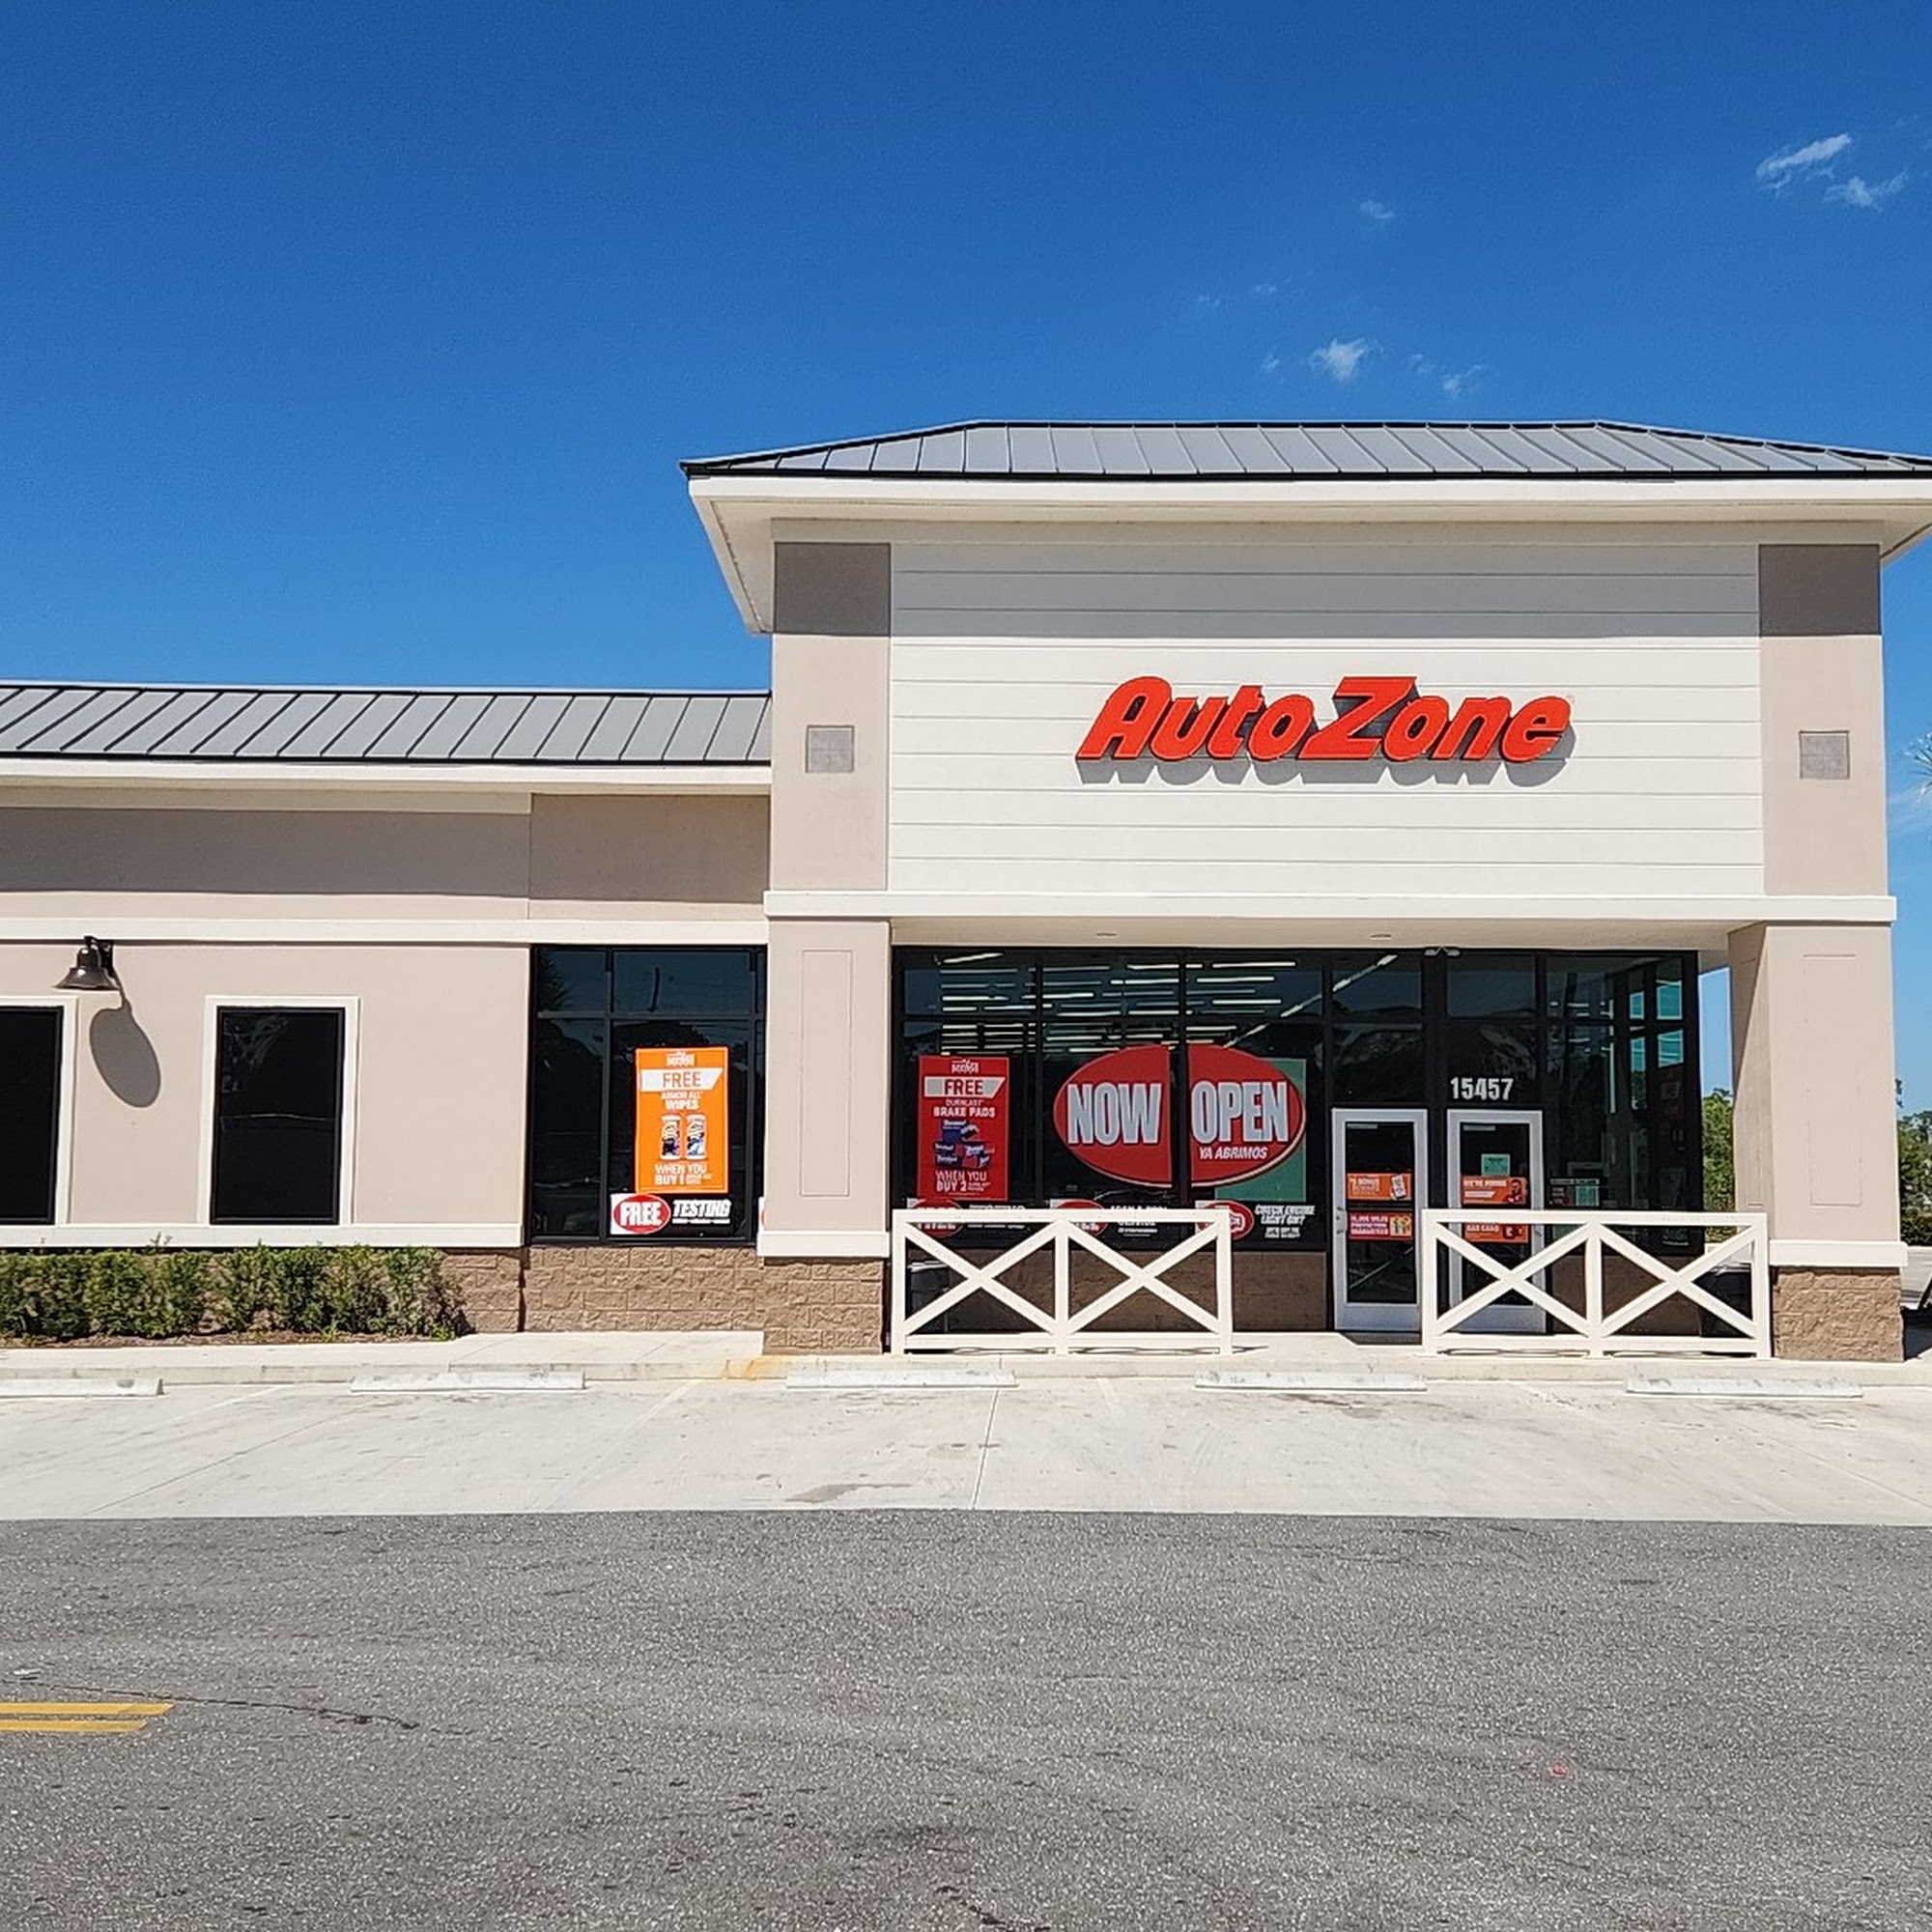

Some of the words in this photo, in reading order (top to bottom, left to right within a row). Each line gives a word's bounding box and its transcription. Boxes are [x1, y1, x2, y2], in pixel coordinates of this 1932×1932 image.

[1076, 675, 1573, 761] AutoZone
[663, 1071, 701, 1088] FREE
[945, 1079, 983, 1095] FREE
[1450, 1077, 1514, 1101] 15457
[666, 1099, 699, 1110] WIPES
[933, 1107, 966, 1118] BRAKE
[969, 1107, 996, 1118] PADS
[1067, 1082, 1162, 1145] NOW
[1190, 1080, 1289, 1144] OPEN
[1199, 1147, 1213, 1159] YA
[1215, 1147, 1268, 1159] ABRIMOS
[655, 1164, 686, 1175] WHEN
[687, 1164, 707, 1175] YOU
[935, 1170, 965, 1181] WHEN
[967, 1171, 987, 1181] YOU
[655, 1175, 677, 1185] BUY
[936, 1180, 958, 1192] BUY
[960, 1180, 967, 1192] 2
[620, 1201, 663, 1226] FREE
[672, 1198, 732, 1217] TESTING
